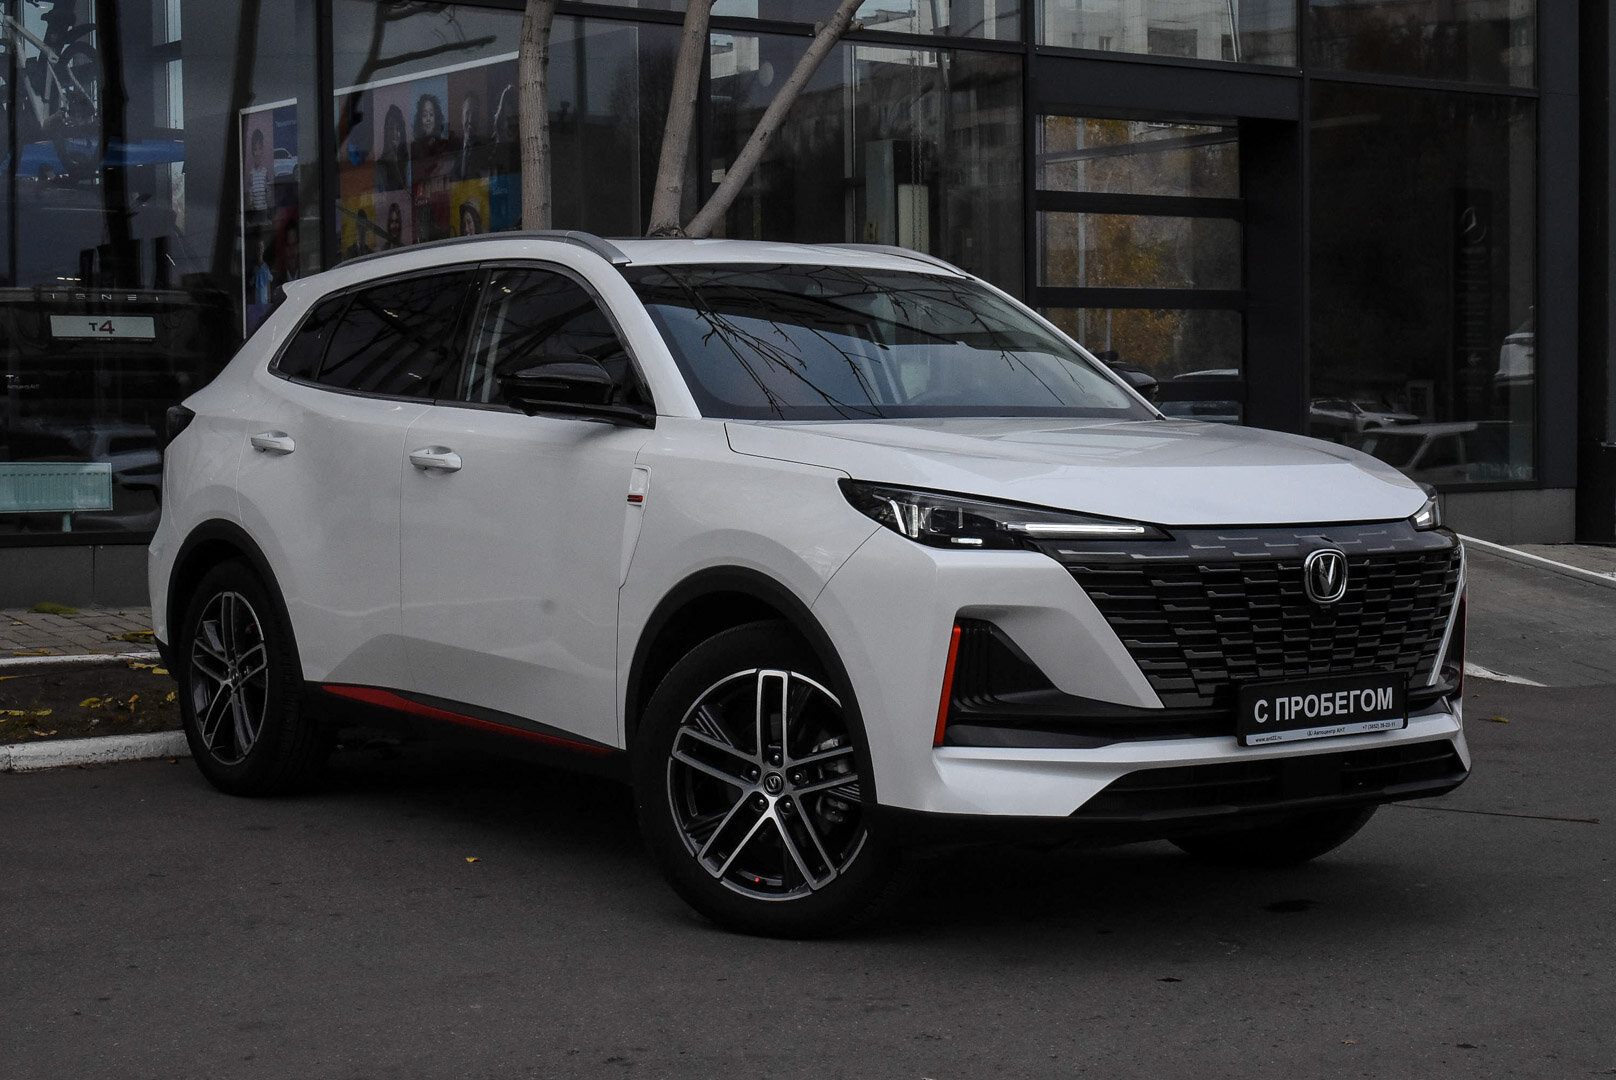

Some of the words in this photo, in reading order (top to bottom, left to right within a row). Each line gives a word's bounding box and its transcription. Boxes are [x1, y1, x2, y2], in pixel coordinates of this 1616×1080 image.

[88, 319, 116, 335] T4
[1254, 699, 1269, 724] С
[1275, 687, 1393, 721] ПРОБЕГОМ
